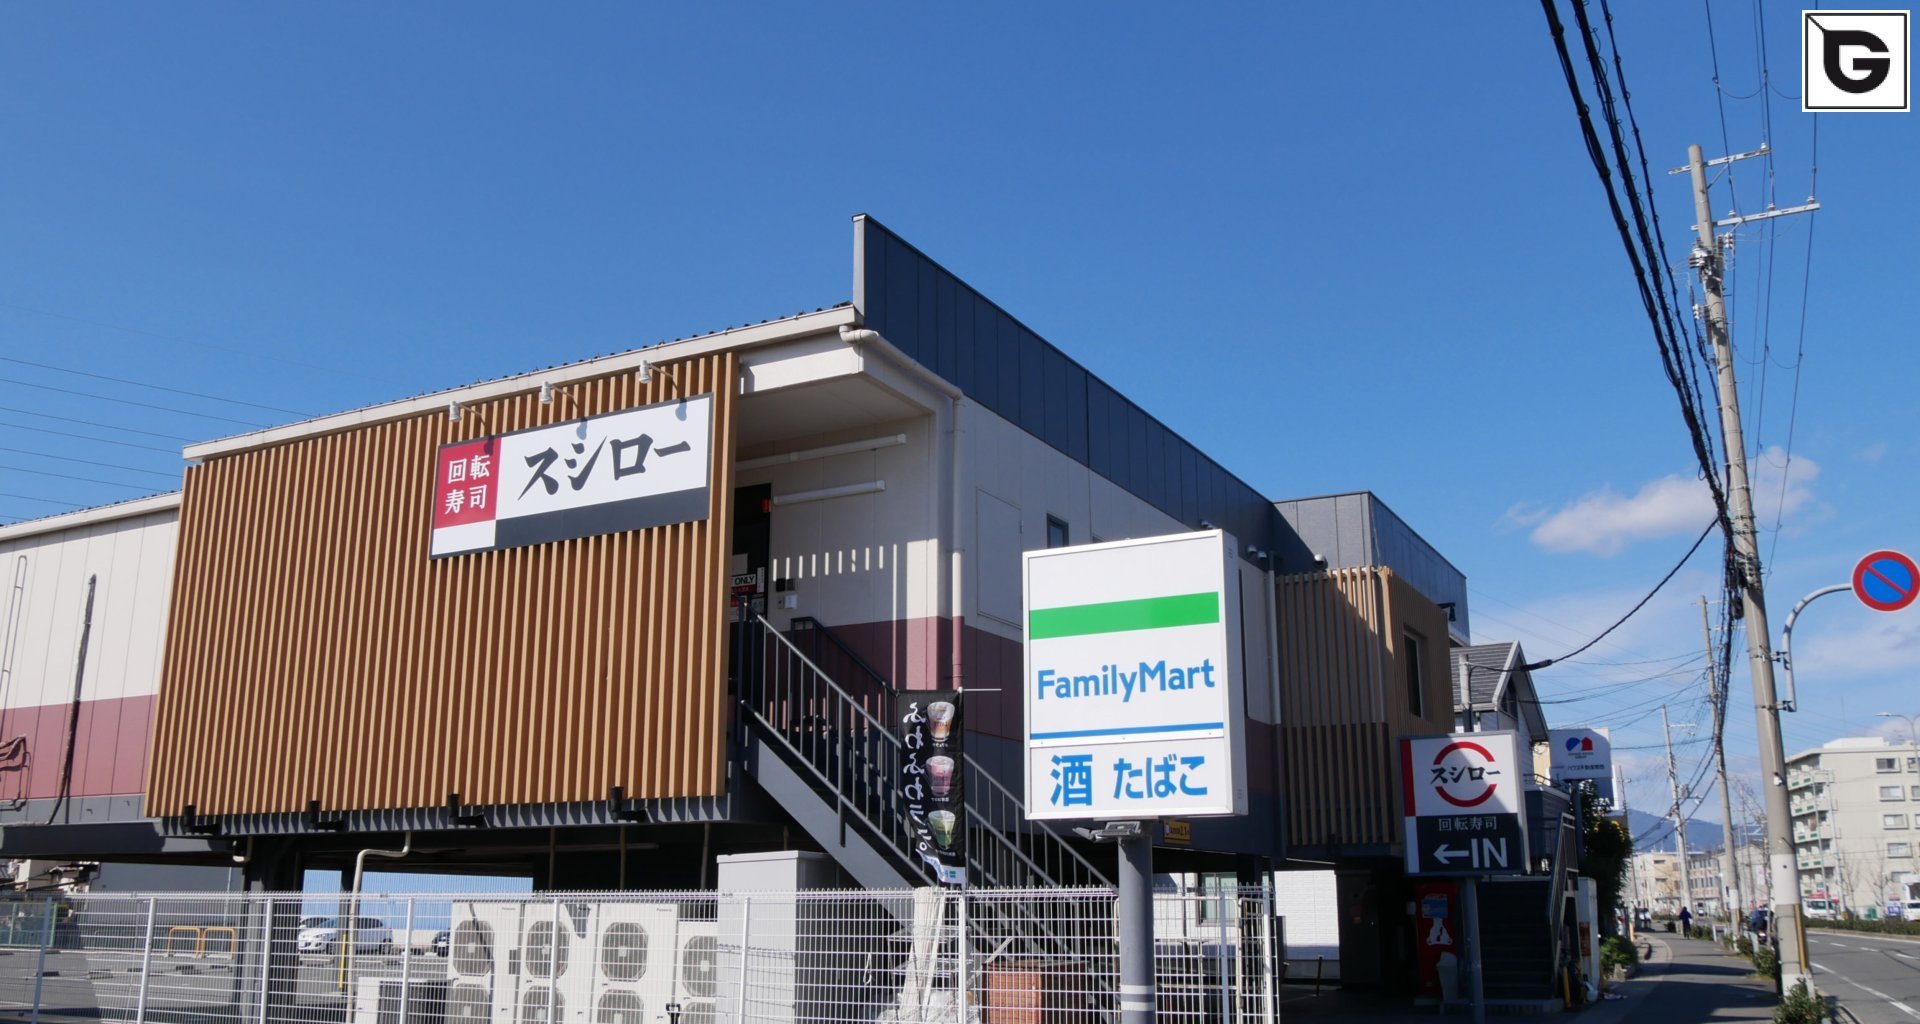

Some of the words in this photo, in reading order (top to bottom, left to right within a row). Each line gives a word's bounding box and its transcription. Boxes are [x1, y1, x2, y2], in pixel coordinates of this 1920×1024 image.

[447, 454, 491, 484] 回転
[517, 433, 692, 501] スシロー
[444, 485, 488, 515] 寿司
[734, 575, 755, 586] ONLY
[1037, 658, 1215, 703] FamilyMart
[1050, 754, 1093, 807] 酒
[1113, 753, 1208, 800] たばこ
[1430, 765, 1501, 784] スシロー
[1438, 816, 1497, 831] 回転寿司
[1471, 837, 1508, 868] IN
